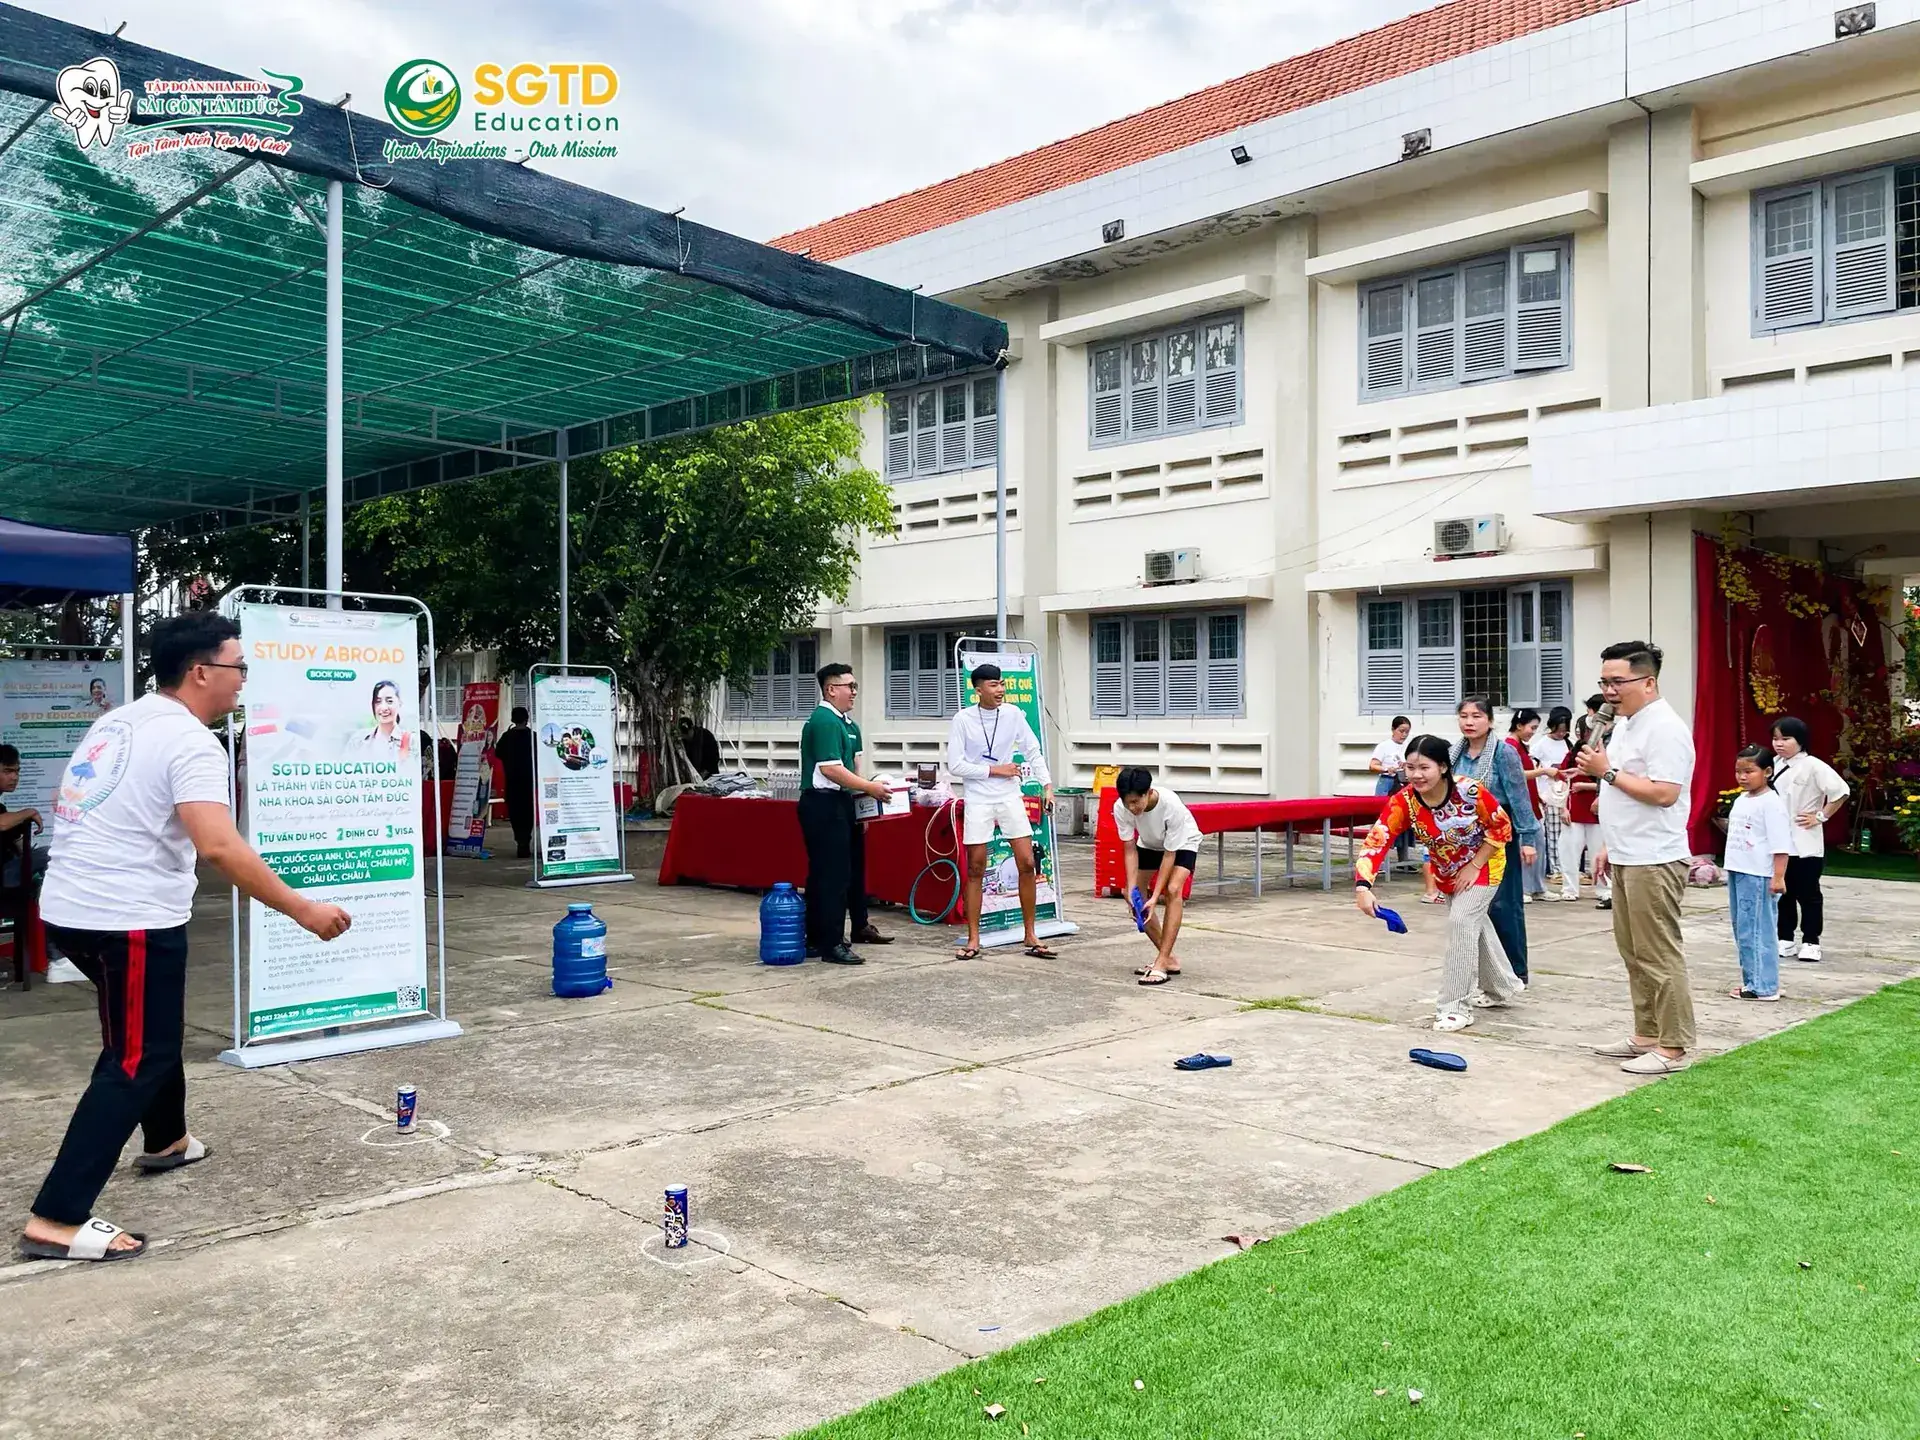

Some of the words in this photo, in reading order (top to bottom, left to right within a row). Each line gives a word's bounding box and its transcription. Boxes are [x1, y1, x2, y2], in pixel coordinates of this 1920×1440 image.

[254, 641, 318, 661] STUDY
[324, 645, 405, 664] ABROAD
[310, 670, 332, 679] BOOK
[333, 671, 353, 679] NOW
[47, 711, 100, 719] EDUCATIO
[272, 763, 311, 777] SGTD
[315, 762, 397, 776] EDUCATION
[255, 781, 269, 792] LÀ
[271, 779, 307, 792] THÀNH
[309, 778, 332, 791] VIÊN
[335, 777, 357, 790] CỦA
[359, 777, 379, 791] TẬP
[259, 797, 282, 807] NHA
[285, 796, 314, 806] KHOA
[386, 792, 410, 803] ĐỨC
[295, 832, 307, 841] DU
[309, 832, 328, 843] HỌC
[345, 828, 365, 840] ĐỊNH
[367, 828, 380, 838] CƯ
[394, 827, 414, 836] VISA
[282, 851, 308, 863] QUỐC
[309, 853, 323, 861] GIA
[325, 852, 343, 862] ANH,
[375, 847, 410, 857] CANADA
[290, 862, 316, 874] QUỐC
[317, 864, 332, 872] GIA
[333, 861, 356, 871] CHÂU
[370, 858, 393, 868] CHÂU
[303, 873, 326, 884] CHÂU
[341, 870, 364, 880] CHÂU
